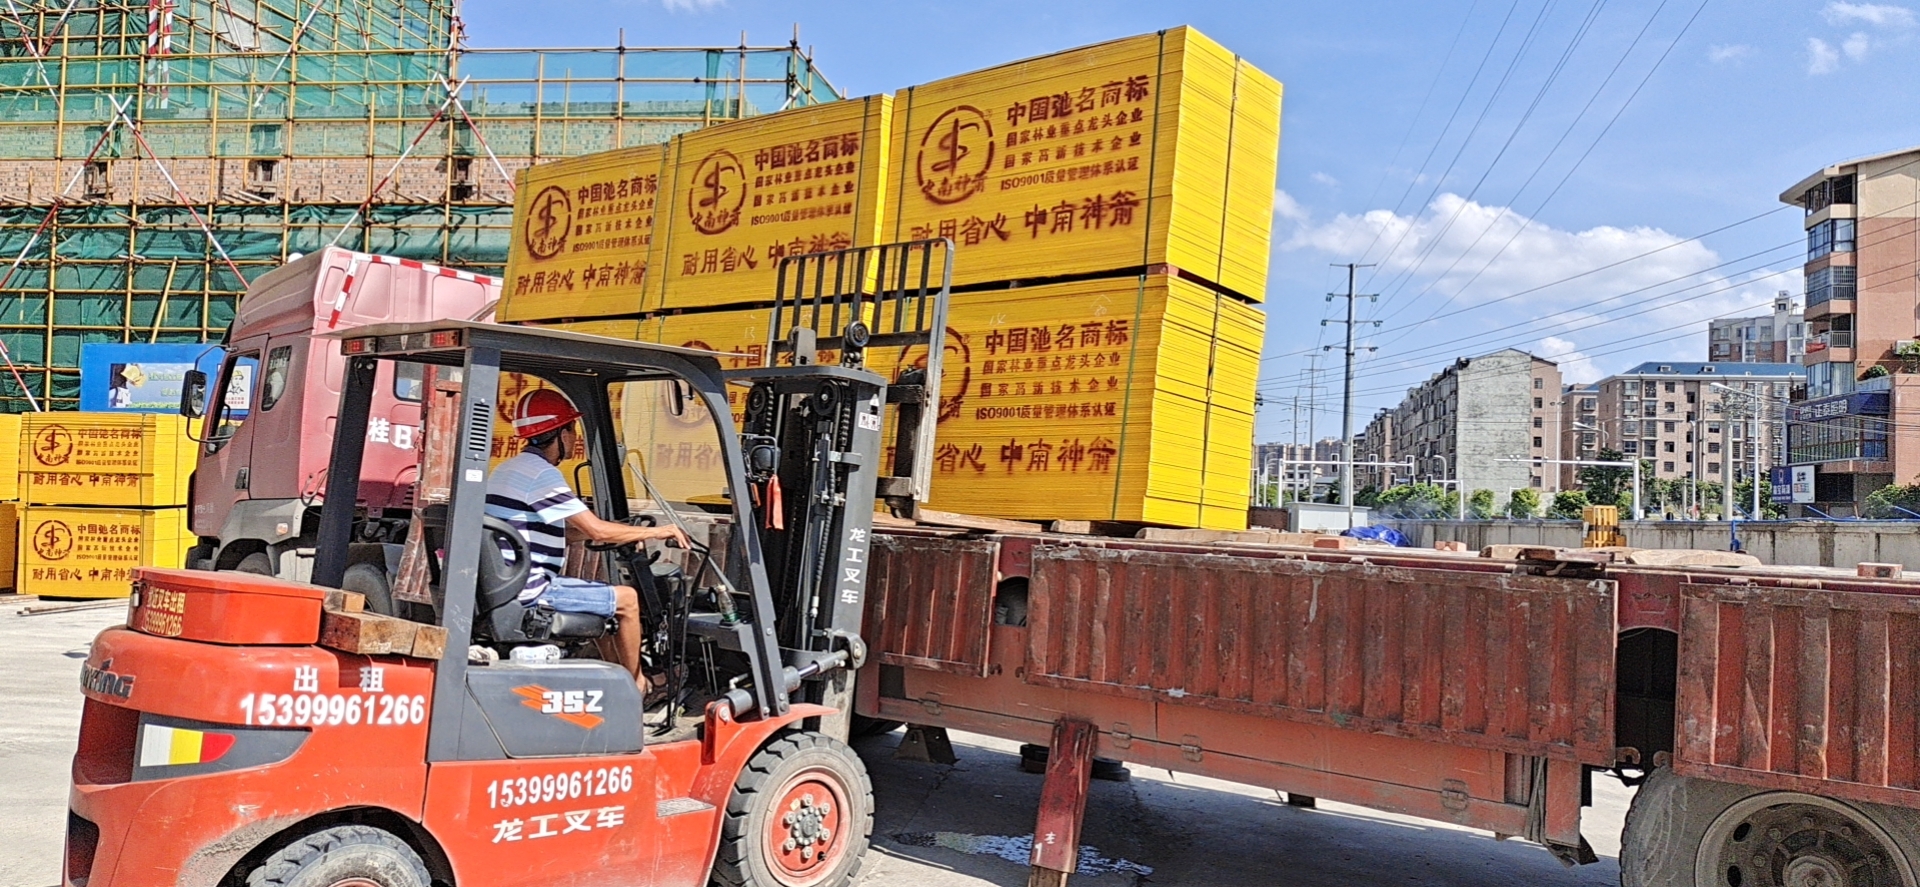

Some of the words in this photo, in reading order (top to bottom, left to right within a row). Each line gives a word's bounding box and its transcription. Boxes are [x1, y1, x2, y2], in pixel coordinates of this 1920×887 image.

[681, 245, 758, 276] 耐用省心
[515, 268, 574, 296] 耐用省心
[33, 567, 83, 580] 耐用省心
[840, 527, 867, 605] 龙工叉车
[240, 693, 425, 726] 15399961266
[487, 765, 633, 809] 15399961266
[491, 805, 625, 844] 龙工叉车
